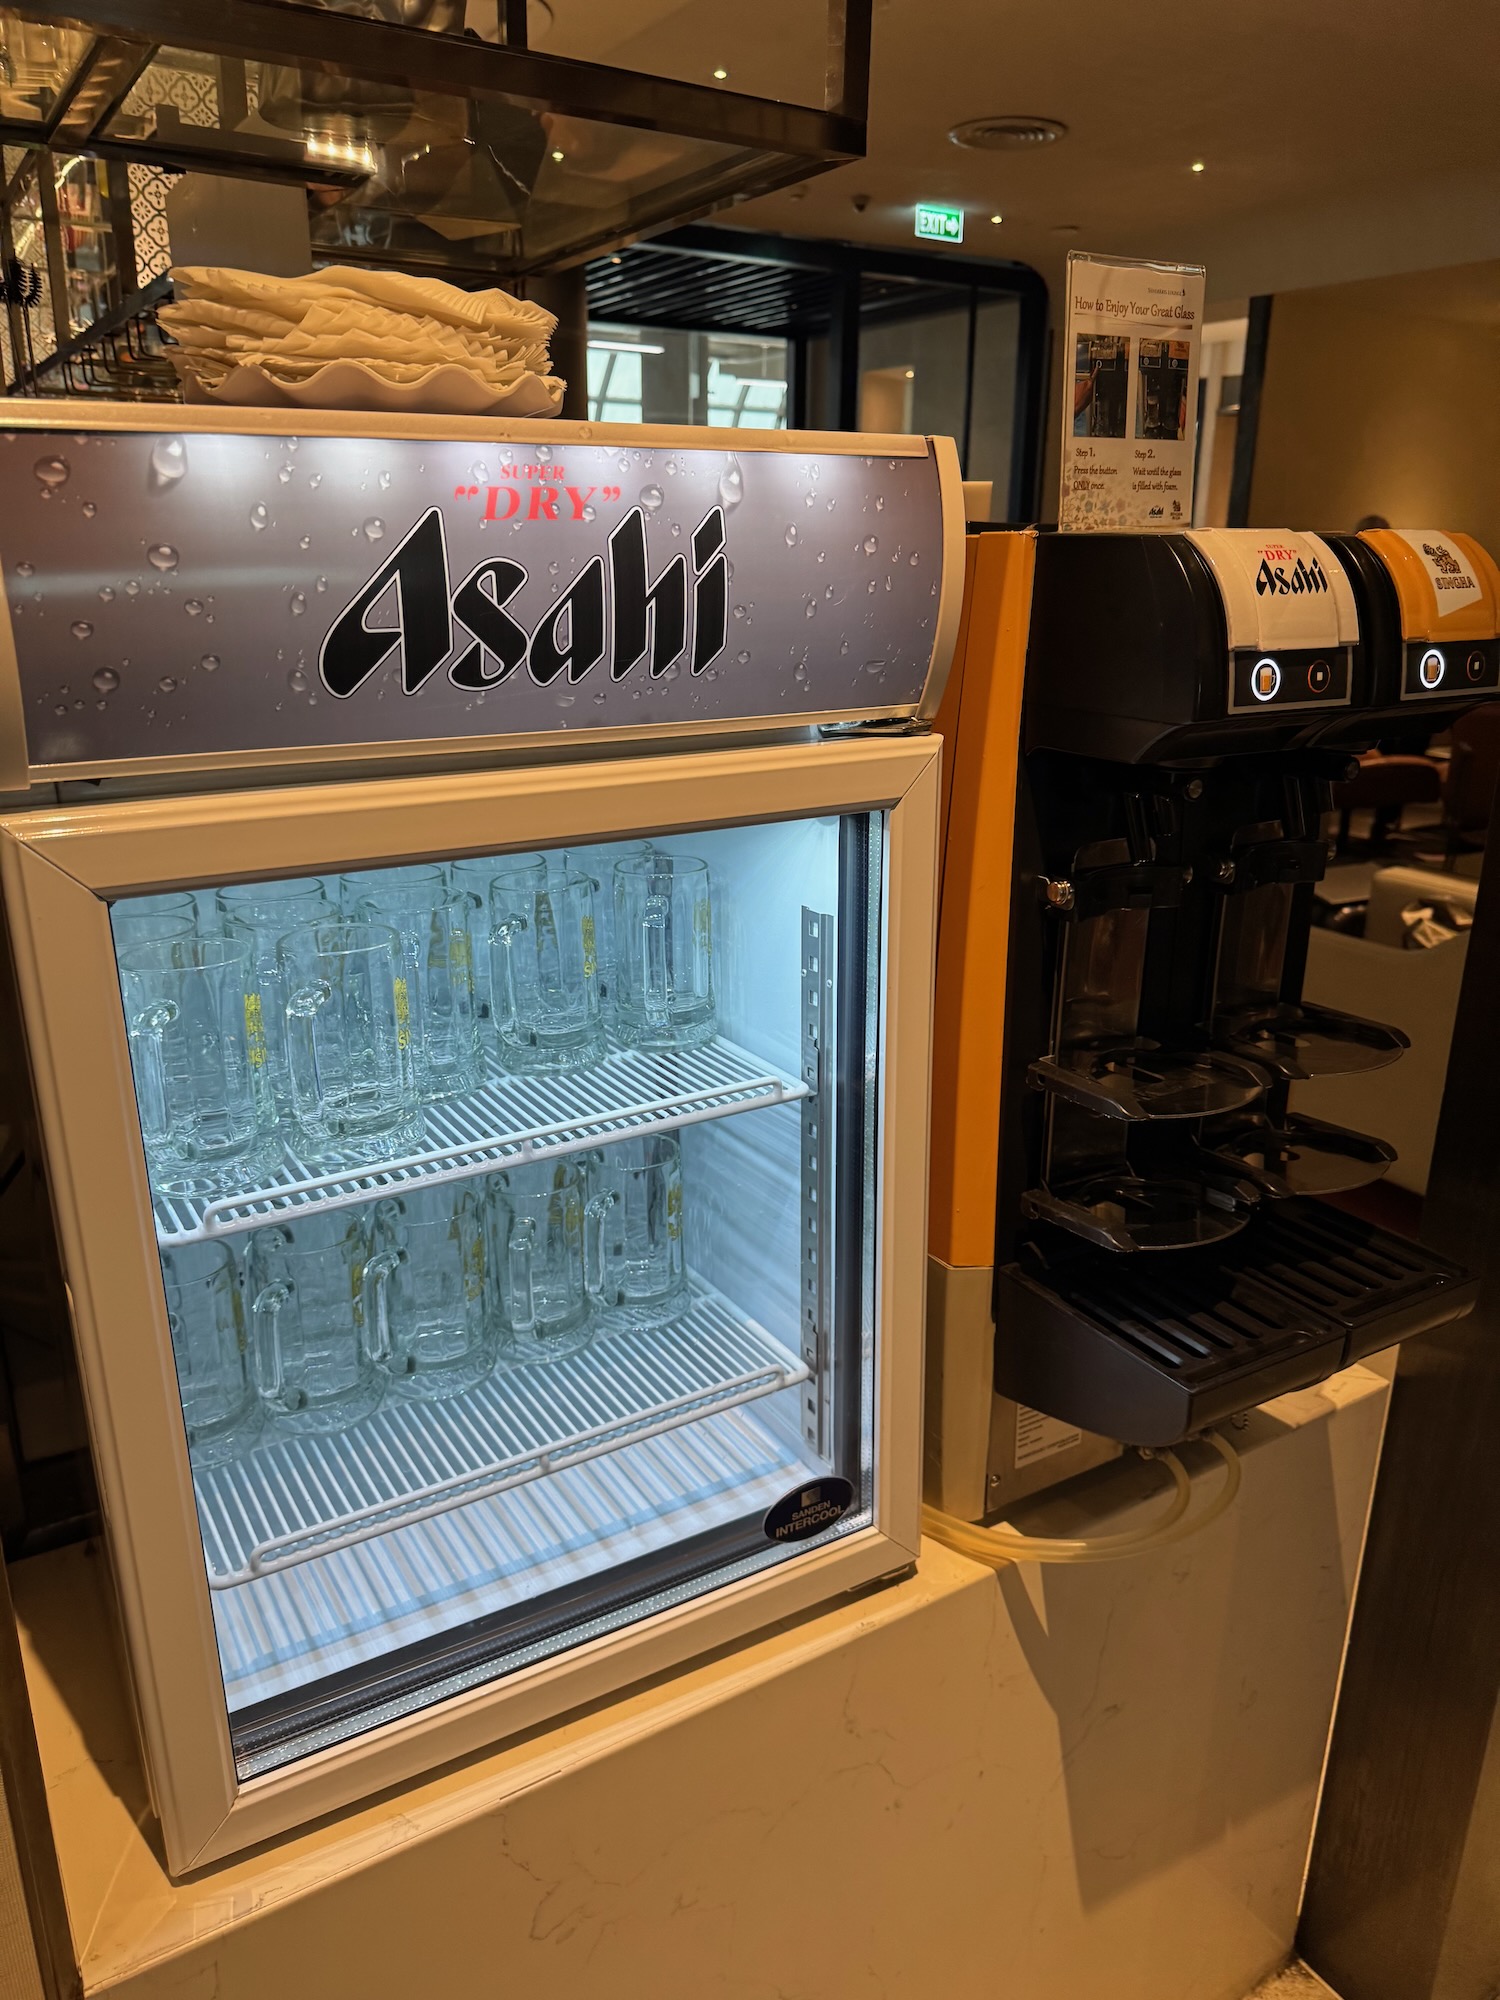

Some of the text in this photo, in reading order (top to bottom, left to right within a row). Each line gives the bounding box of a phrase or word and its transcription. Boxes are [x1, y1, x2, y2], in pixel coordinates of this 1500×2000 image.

[920, 210, 947, 235] EXIT
[1075, 296, 1195, 320] How to Enjoy Your Great Glass
[1076, 447, 1096, 459] Step 1.
[1135, 448, 1156, 461] Step 2.
[500, 463, 566, 481] SUPER
[1073, 465, 1089, 475] Press
[1089, 465, 1099, 475] the
[1132, 466, 1182, 479] Wait until the glass
[1073, 480, 1090, 490] ONLY
[1132, 481, 1137, 490] is
[1135, 480, 1152, 493] filled
[1151, 480, 1164, 491] with
[1257, 549, 1297, 561] "DRY"
[1255, 556, 1329, 597] Asahi
[1434, 576, 1476, 591] SINGHA
[318, 505, 728, 699] Asahi
[792, 1500, 831, 1521] SANDEN
[775, 1504, 844, 1538] INTERCOOL
